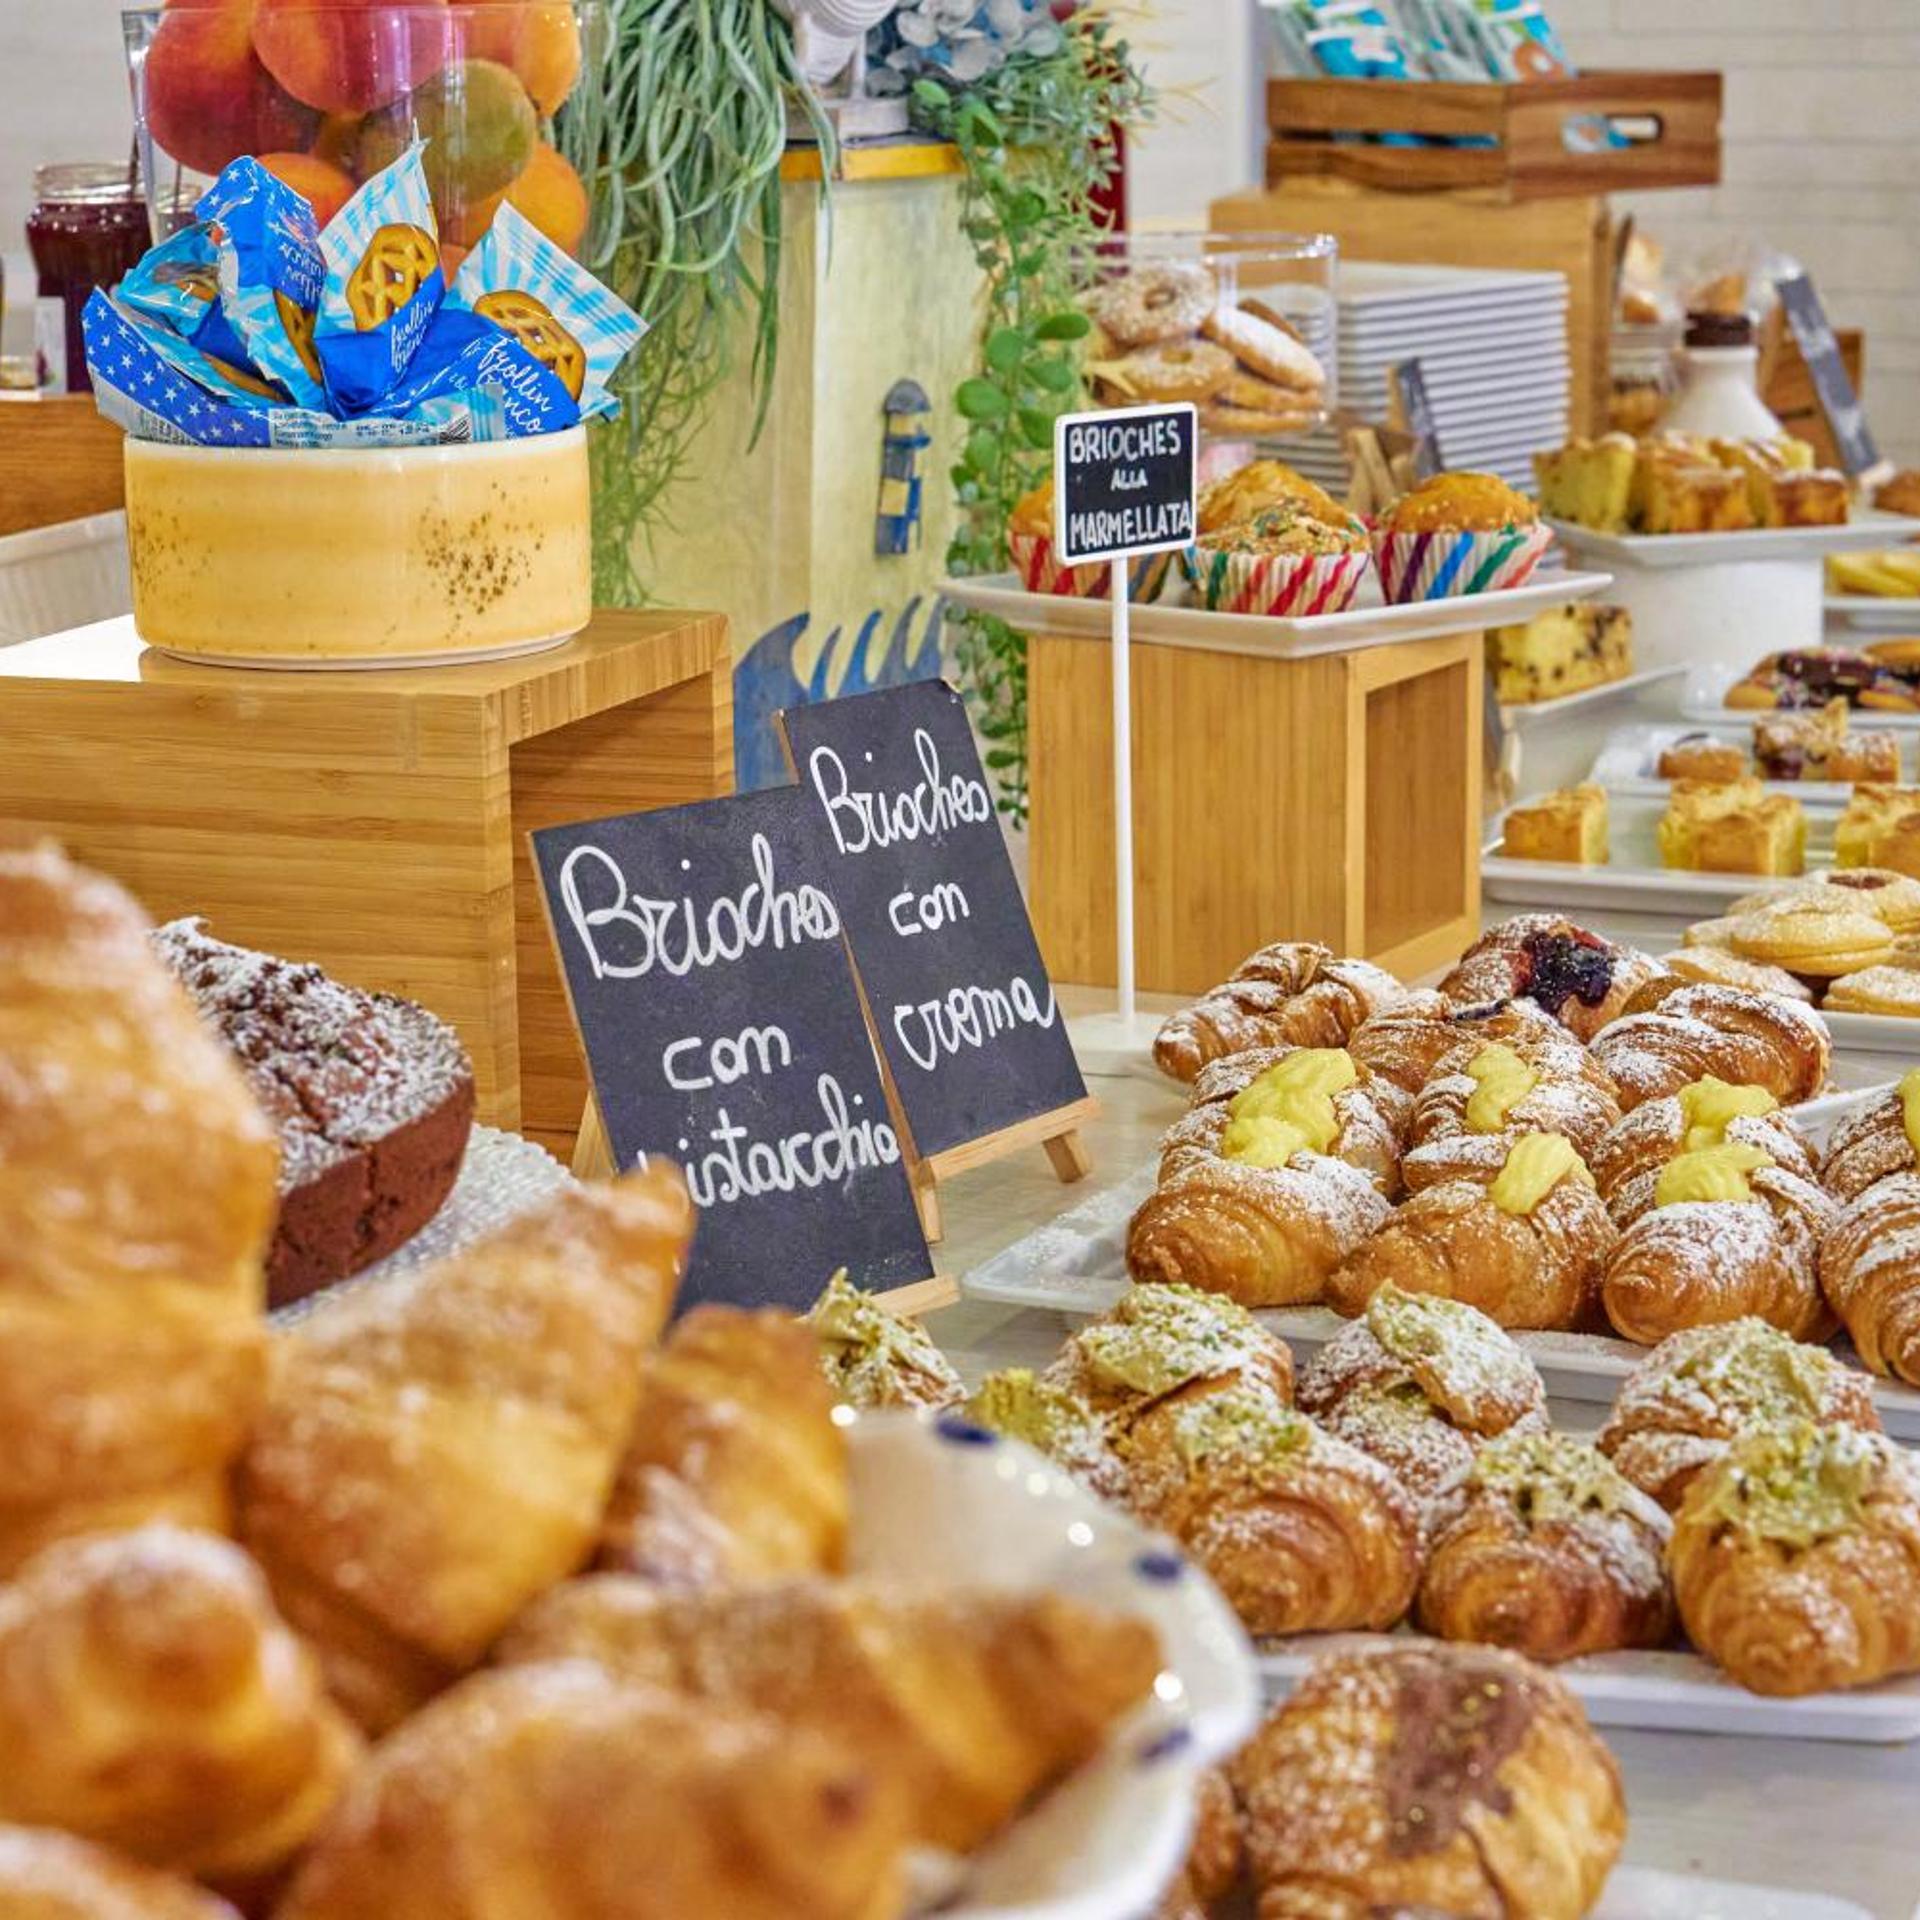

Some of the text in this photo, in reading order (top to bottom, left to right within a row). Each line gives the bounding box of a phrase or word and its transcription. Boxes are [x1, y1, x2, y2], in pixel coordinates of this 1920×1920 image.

[1069, 419, 1182, 463] BRIOCHES
[1110, 468, 1149, 491] ALLA
[1070, 500, 1193, 551] MARMELLATA
[810, 728, 989, 854] Brioches
[559, 832, 841, 979] Brioches
[889, 882, 970, 936] con
[893, 976, 1056, 1072] crema
[662, 1025, 791, 1090] con
[637, 1072, 901, 1207] istacchio
